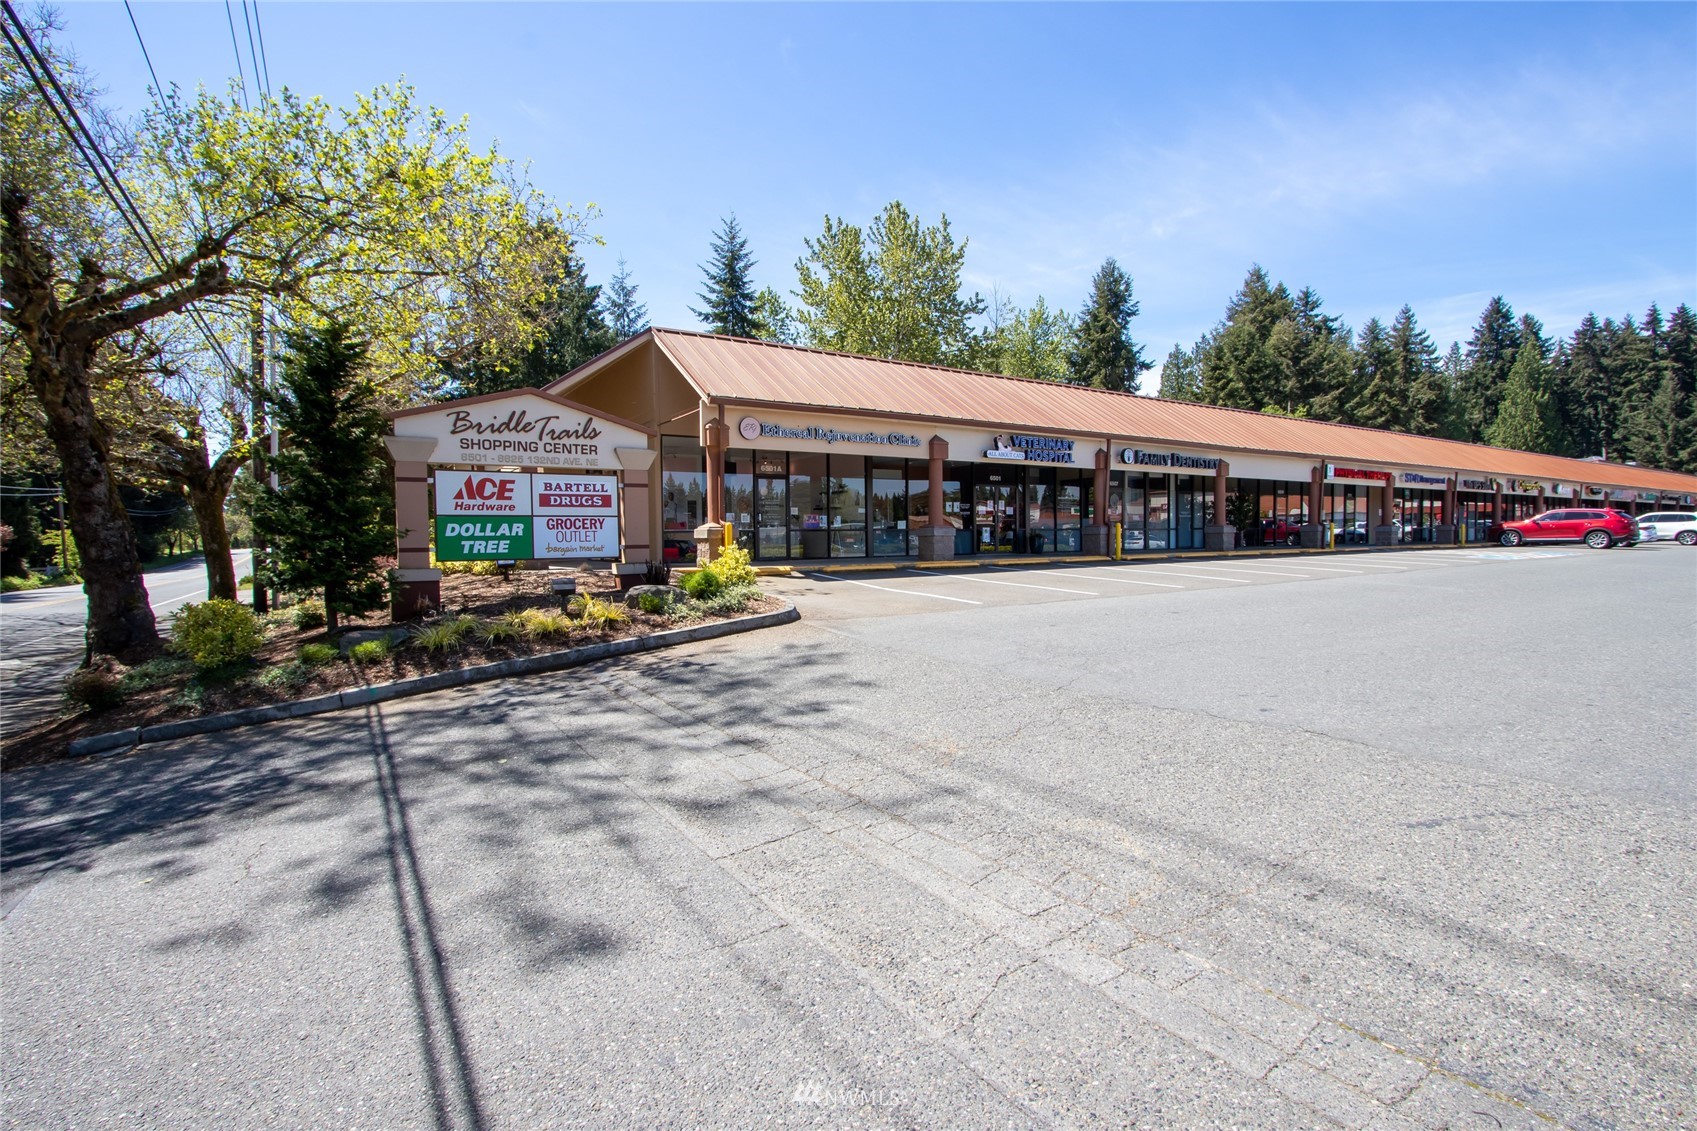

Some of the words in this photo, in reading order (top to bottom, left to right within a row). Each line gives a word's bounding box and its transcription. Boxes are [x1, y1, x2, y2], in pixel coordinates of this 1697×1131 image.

[447, 410, 535, 434] Bridle
[534, 415, 602, 441] Trails
[460, 438, 538, 452] SHOPPING
[543, 442, 598, 455] CENTER
[1011, 434, 1075, 450] VETERINARY
[527, 456, 560, 465] 132ND
[586, 458, 599, 466] NE
[1025, 450, 1075, 463] HOSPITAL
[1135, 450, 1171, 466] FAMILY
[1171, 453, 1219, 469] DENTISTRY
[453, 475, 515, 500] ACE
[543, 482, 608, 492] BARTELL
[454, 502, 516, 511] Hardware
[550, 495, 602, 506] DRUGS
[445, 523, 524, 537] DOLLAR
[546, 518, 605, 530] GROCERY
[556, 530, 598, 543] OUTLET
[461, 540, 510, 554] TREE
[545, 545, 577, 556] bargain
[579, 545, 604, 553] market
